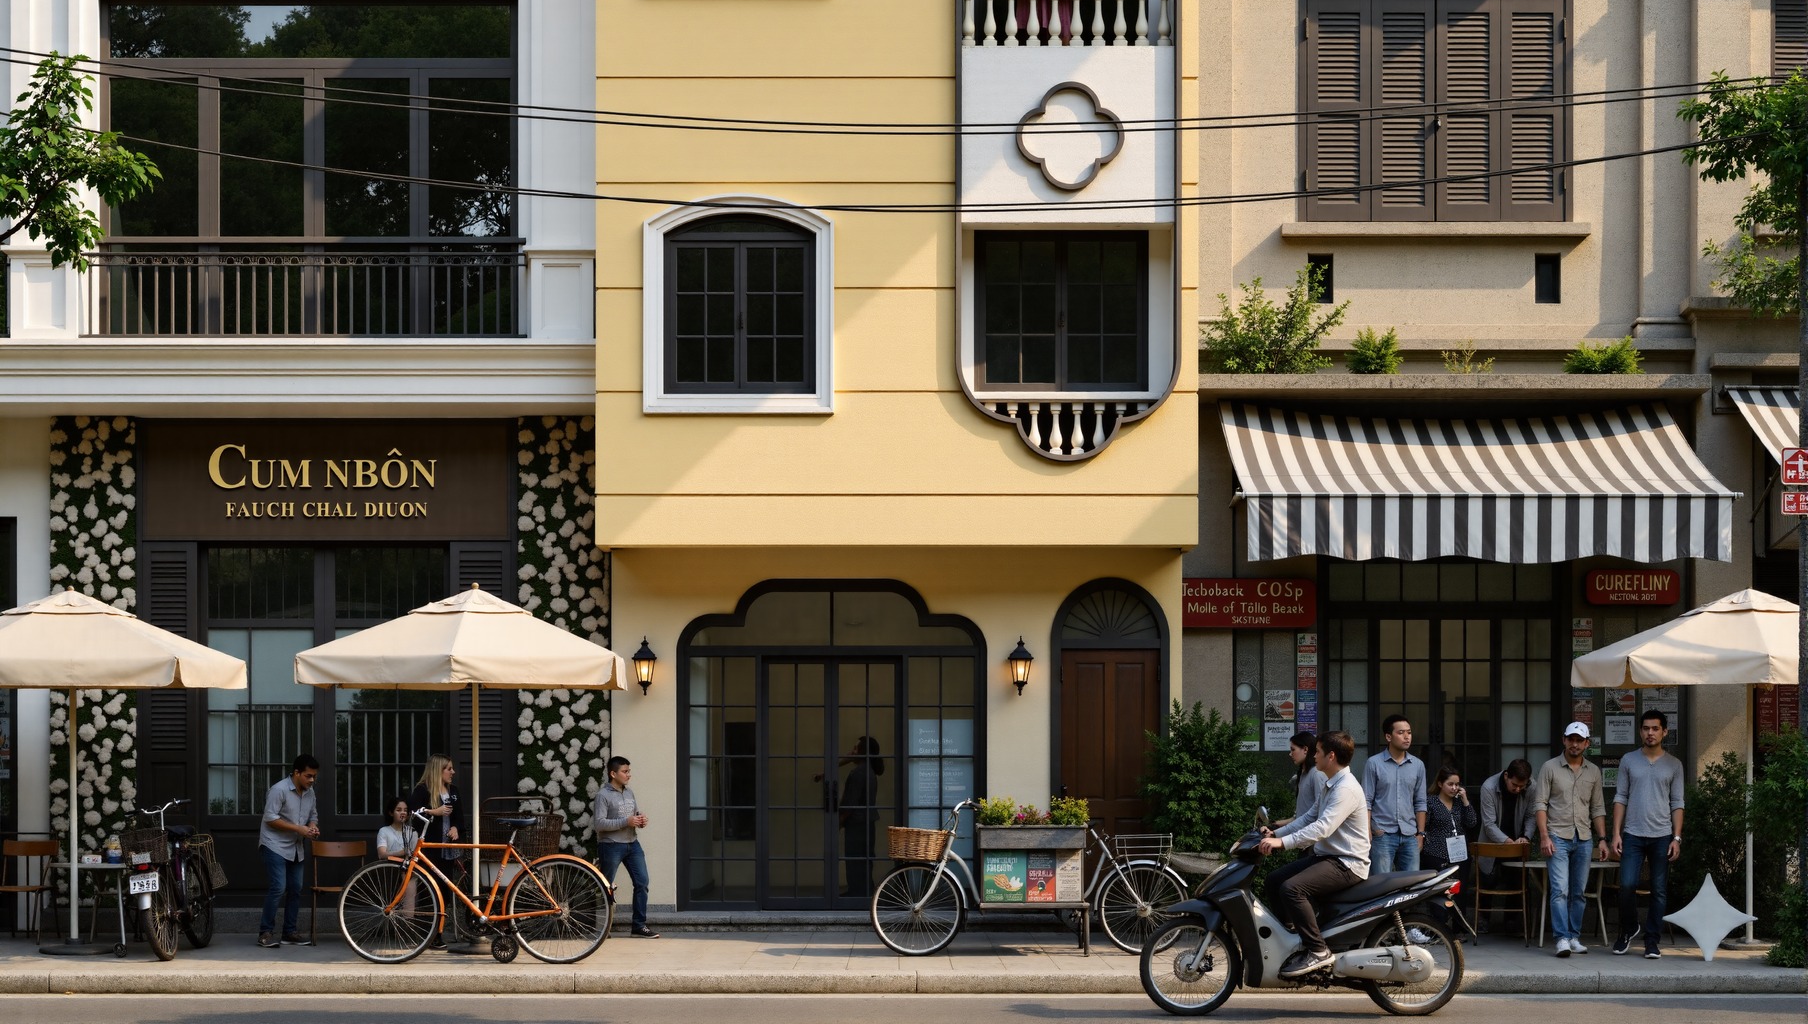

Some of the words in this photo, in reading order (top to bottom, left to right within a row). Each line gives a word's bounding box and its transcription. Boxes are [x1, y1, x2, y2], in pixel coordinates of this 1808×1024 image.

[324, 447, 438, 489] NBÔN
[225, 501, 295, 518] FAUCH
[302, 501, 357, 518] CHAL
[364, 501, 428, 518] DIUON
[1595, 574, 1671, 591] CUREFLINY
[1187, 602, 1218, 614] Molle
[1222, 601, 1235, 614] of
